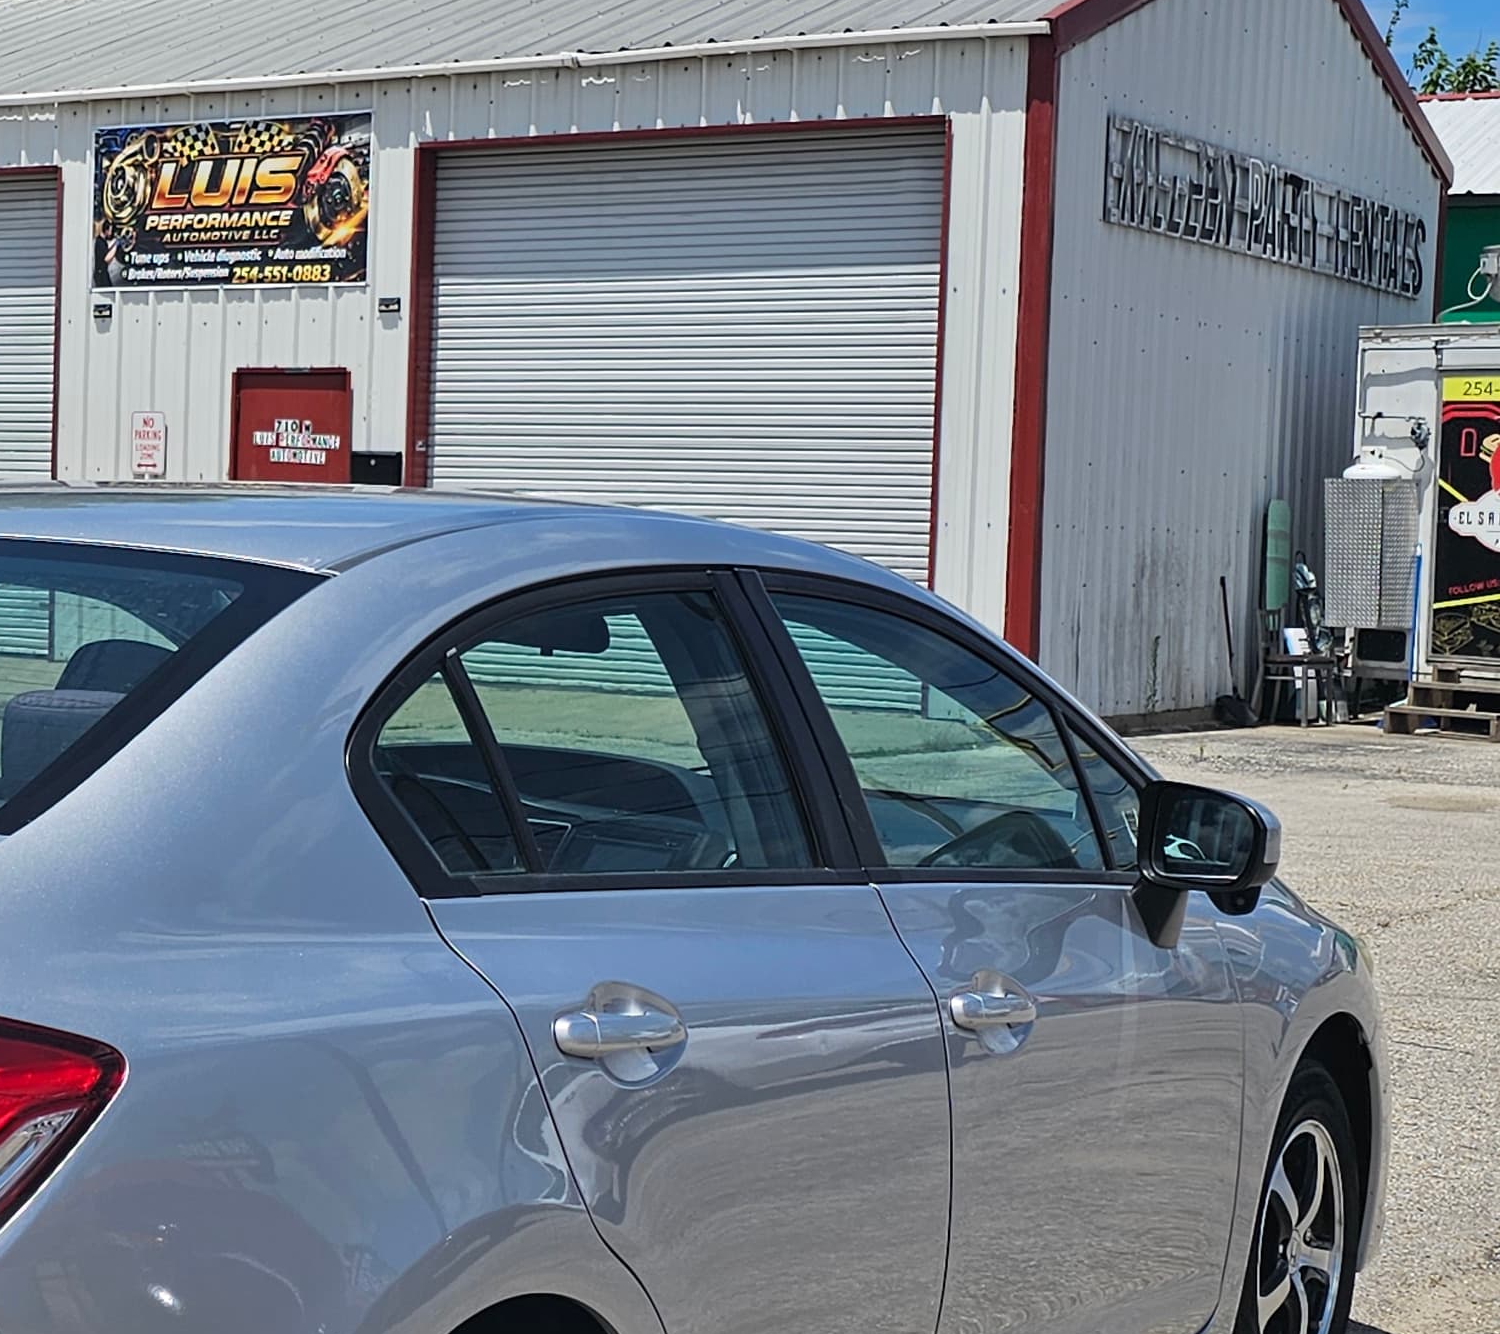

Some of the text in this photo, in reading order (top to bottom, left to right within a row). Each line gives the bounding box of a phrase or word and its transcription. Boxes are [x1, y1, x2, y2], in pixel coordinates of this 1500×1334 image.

[151, 155, 303, 209] LUIS
[1245, 157, 1319, 269] PARTY
[145, 210, 293, 231] PERFORMANCE
[162, 229, 279, 243] AUTOMOTIVE LLC
[152, 253, 170, 266] ups
[184, 248, 262, 265] Vehicle diagnostic
[273, 246, 347, 260] Auto modification
[231, 264, 332, 283] 254-551-0883
[142, 417, 155, 429] NO
[276, 420, 299, 432] 710
[134, 429, 162, 441] PARKING
[1458, 511, 1472, 525] EL
[1448, 581, 1485, 596] FOLLOW
